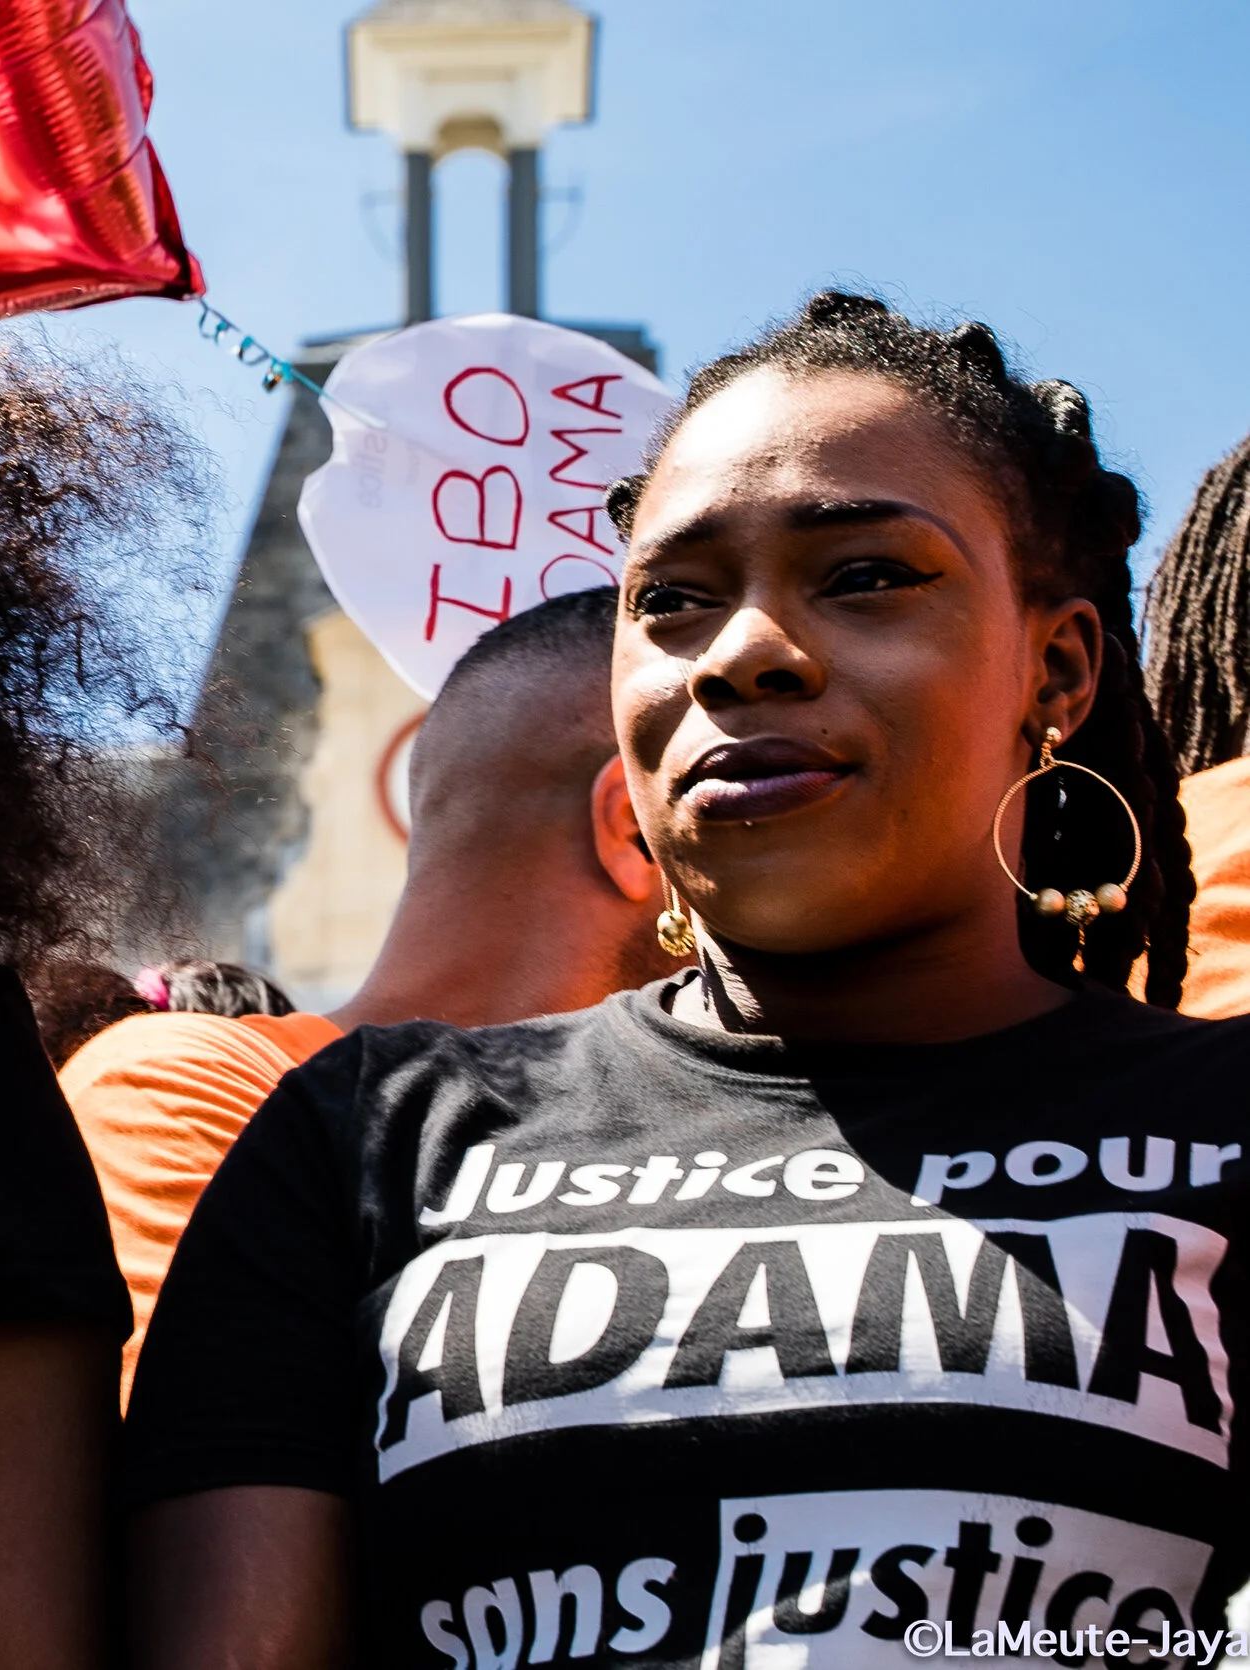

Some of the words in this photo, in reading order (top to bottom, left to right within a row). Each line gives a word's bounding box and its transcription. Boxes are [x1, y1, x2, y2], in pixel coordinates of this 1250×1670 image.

[419, 1144, 866, 1226] Justice
[911, 1135, 1242, 1206] pour
[377, 1228, 1228, 1454] ADAMA
[420, 1557, 678, 1670] sans
[718, 1513, 1190, 1670] justice
